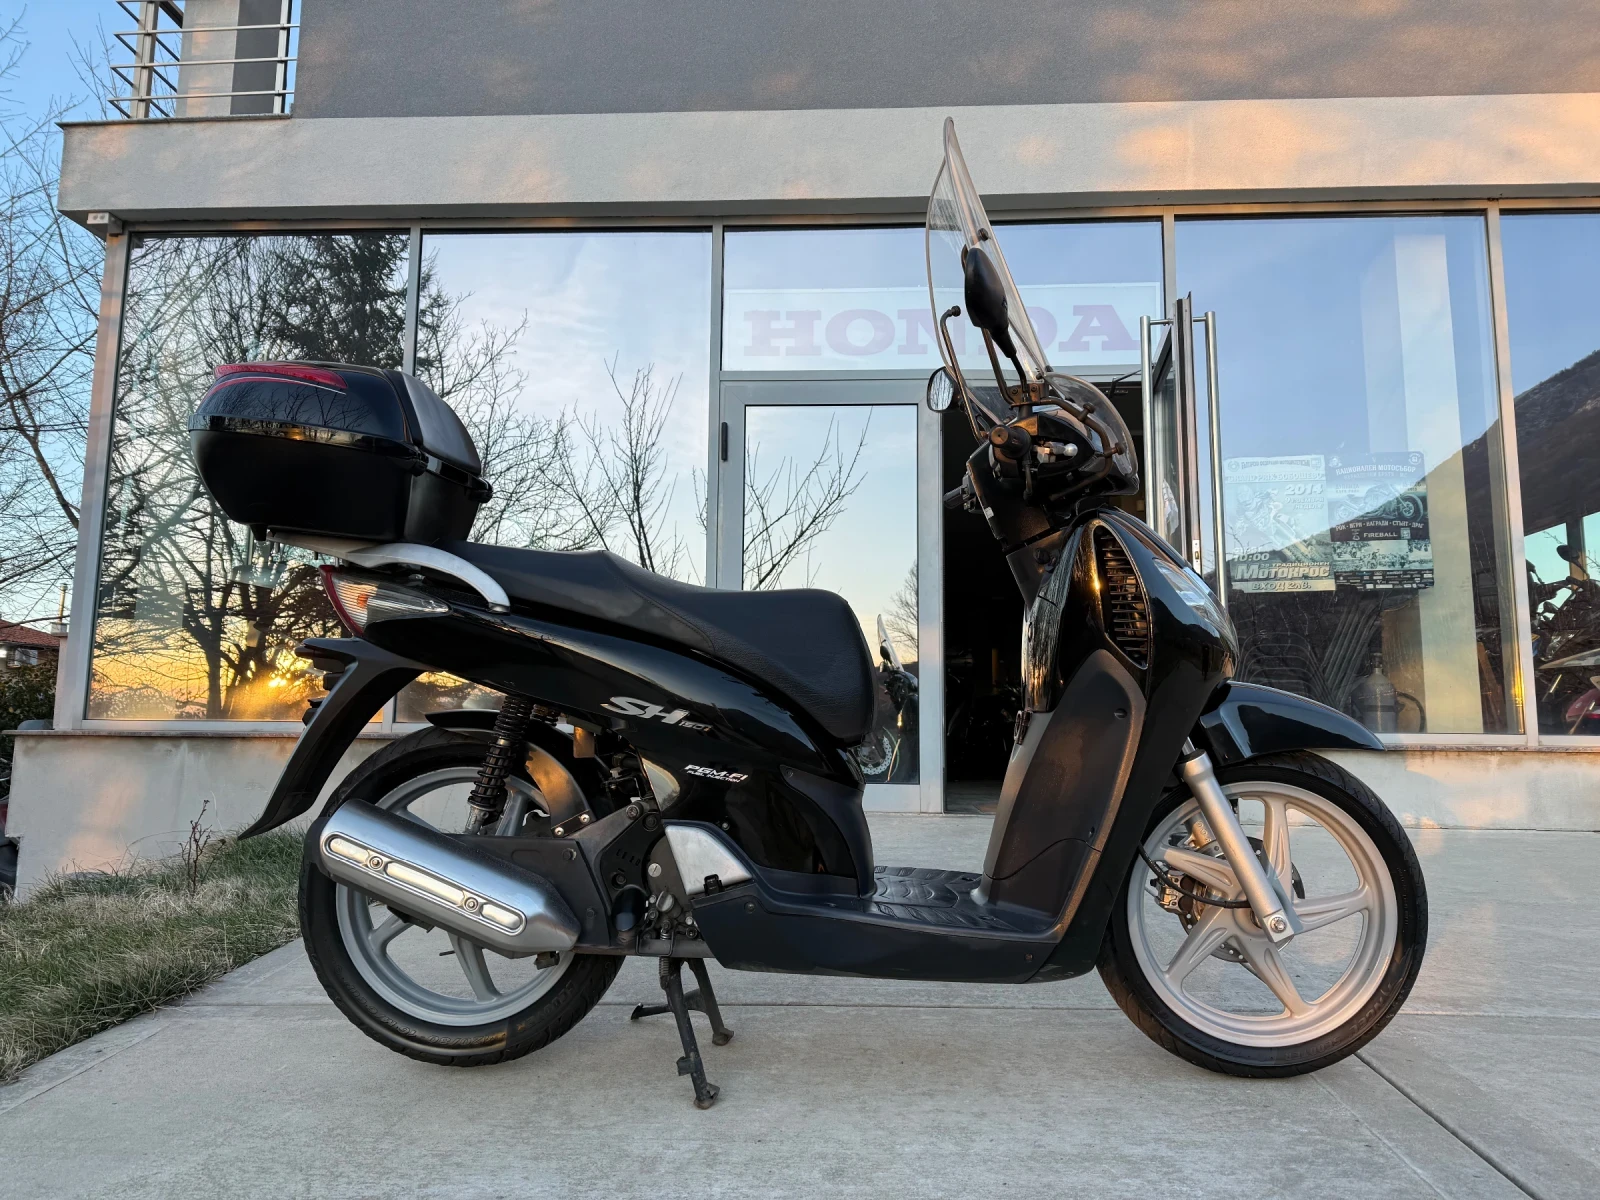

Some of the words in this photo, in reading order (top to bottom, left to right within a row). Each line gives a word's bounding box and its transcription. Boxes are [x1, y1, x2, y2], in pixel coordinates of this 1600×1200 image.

[1378, 464, 1417, 472] МОТОСЪБОР
[1284, 484, 1323, 495] 2014
[1233, 552, 1270, 562] 10:00
[1252, 582, 1285, 591] ВХОД
[600, 696, 690, 724] SH
[687, 770, 705, 778] FUEL
[707, 773, 741, 783] INJECTION
